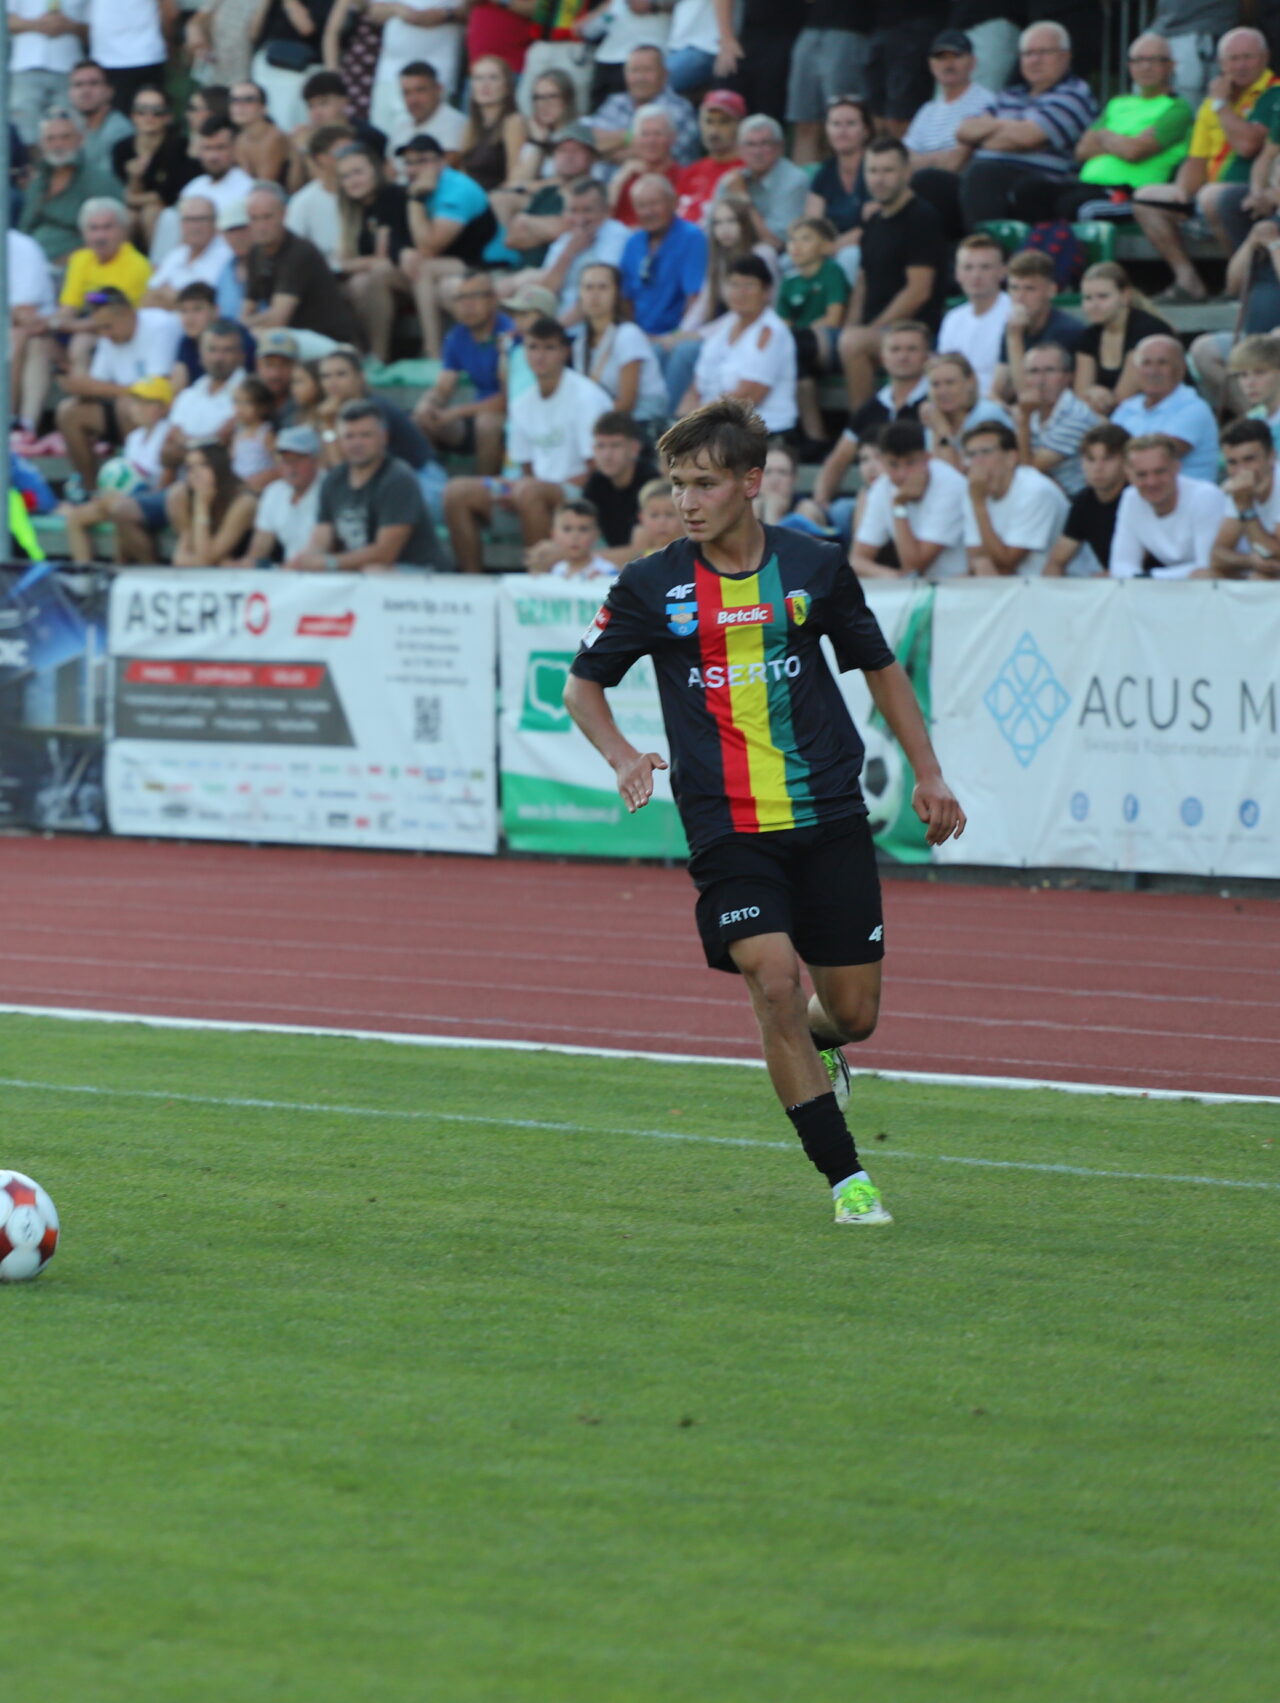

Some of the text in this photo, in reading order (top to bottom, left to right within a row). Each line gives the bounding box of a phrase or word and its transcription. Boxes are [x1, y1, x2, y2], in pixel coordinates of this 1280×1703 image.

[666, 583, 696, 600] 4F
[125, 589, 271, 636] ASERTO
[717, 607, 768, 625] Betclic
[687, 655, 801, 688] ASERTO
[1077, 675, 1278, 734] ACUS M
[869, 925, 883, 942] 4
